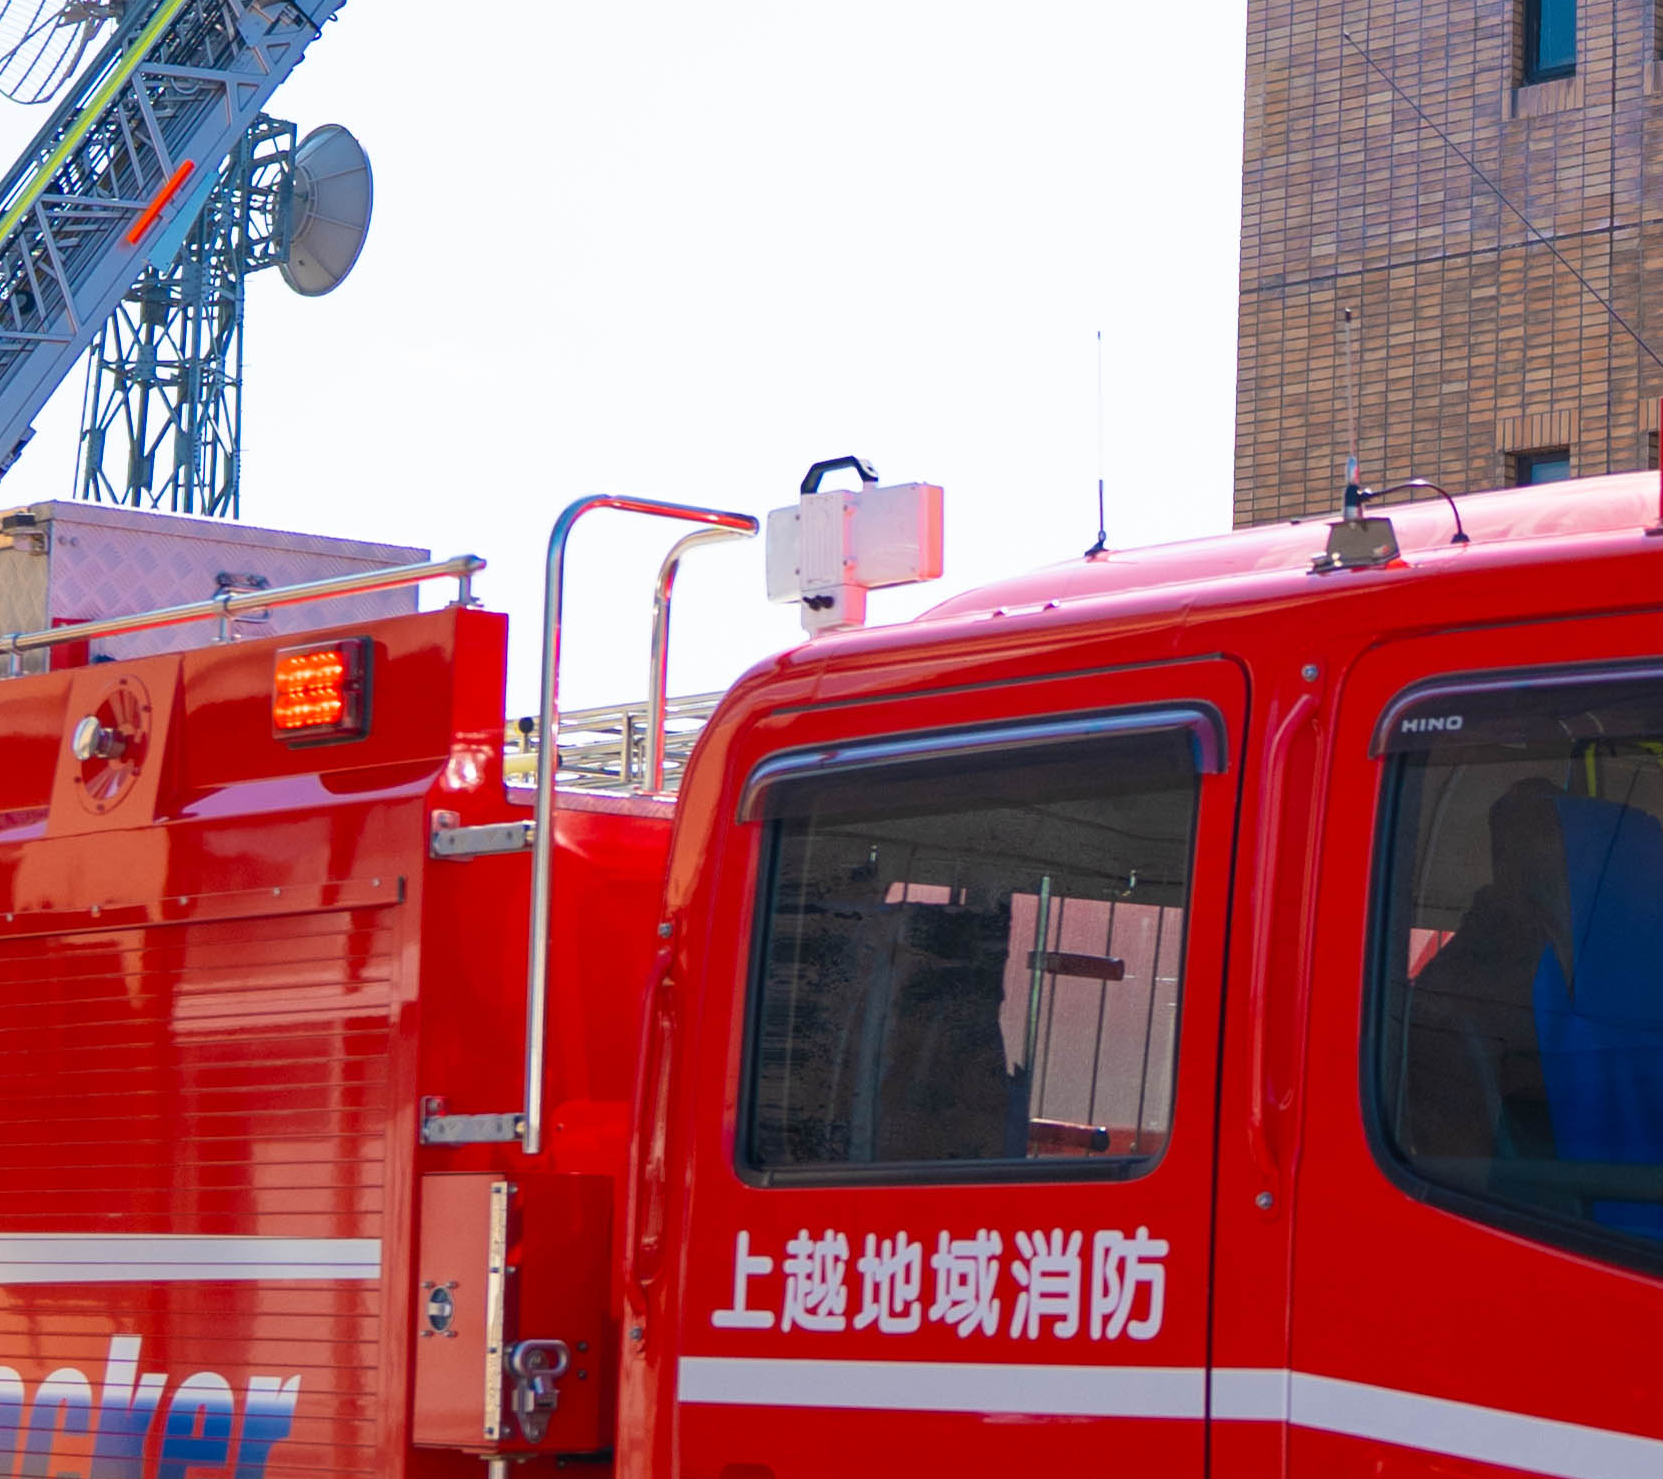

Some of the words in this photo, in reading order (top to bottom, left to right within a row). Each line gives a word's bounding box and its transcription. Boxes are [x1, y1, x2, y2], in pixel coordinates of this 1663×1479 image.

[1401, 715, 1464, 733] HINO
[710, 1225, 1171, 1341] 上越地域消防
